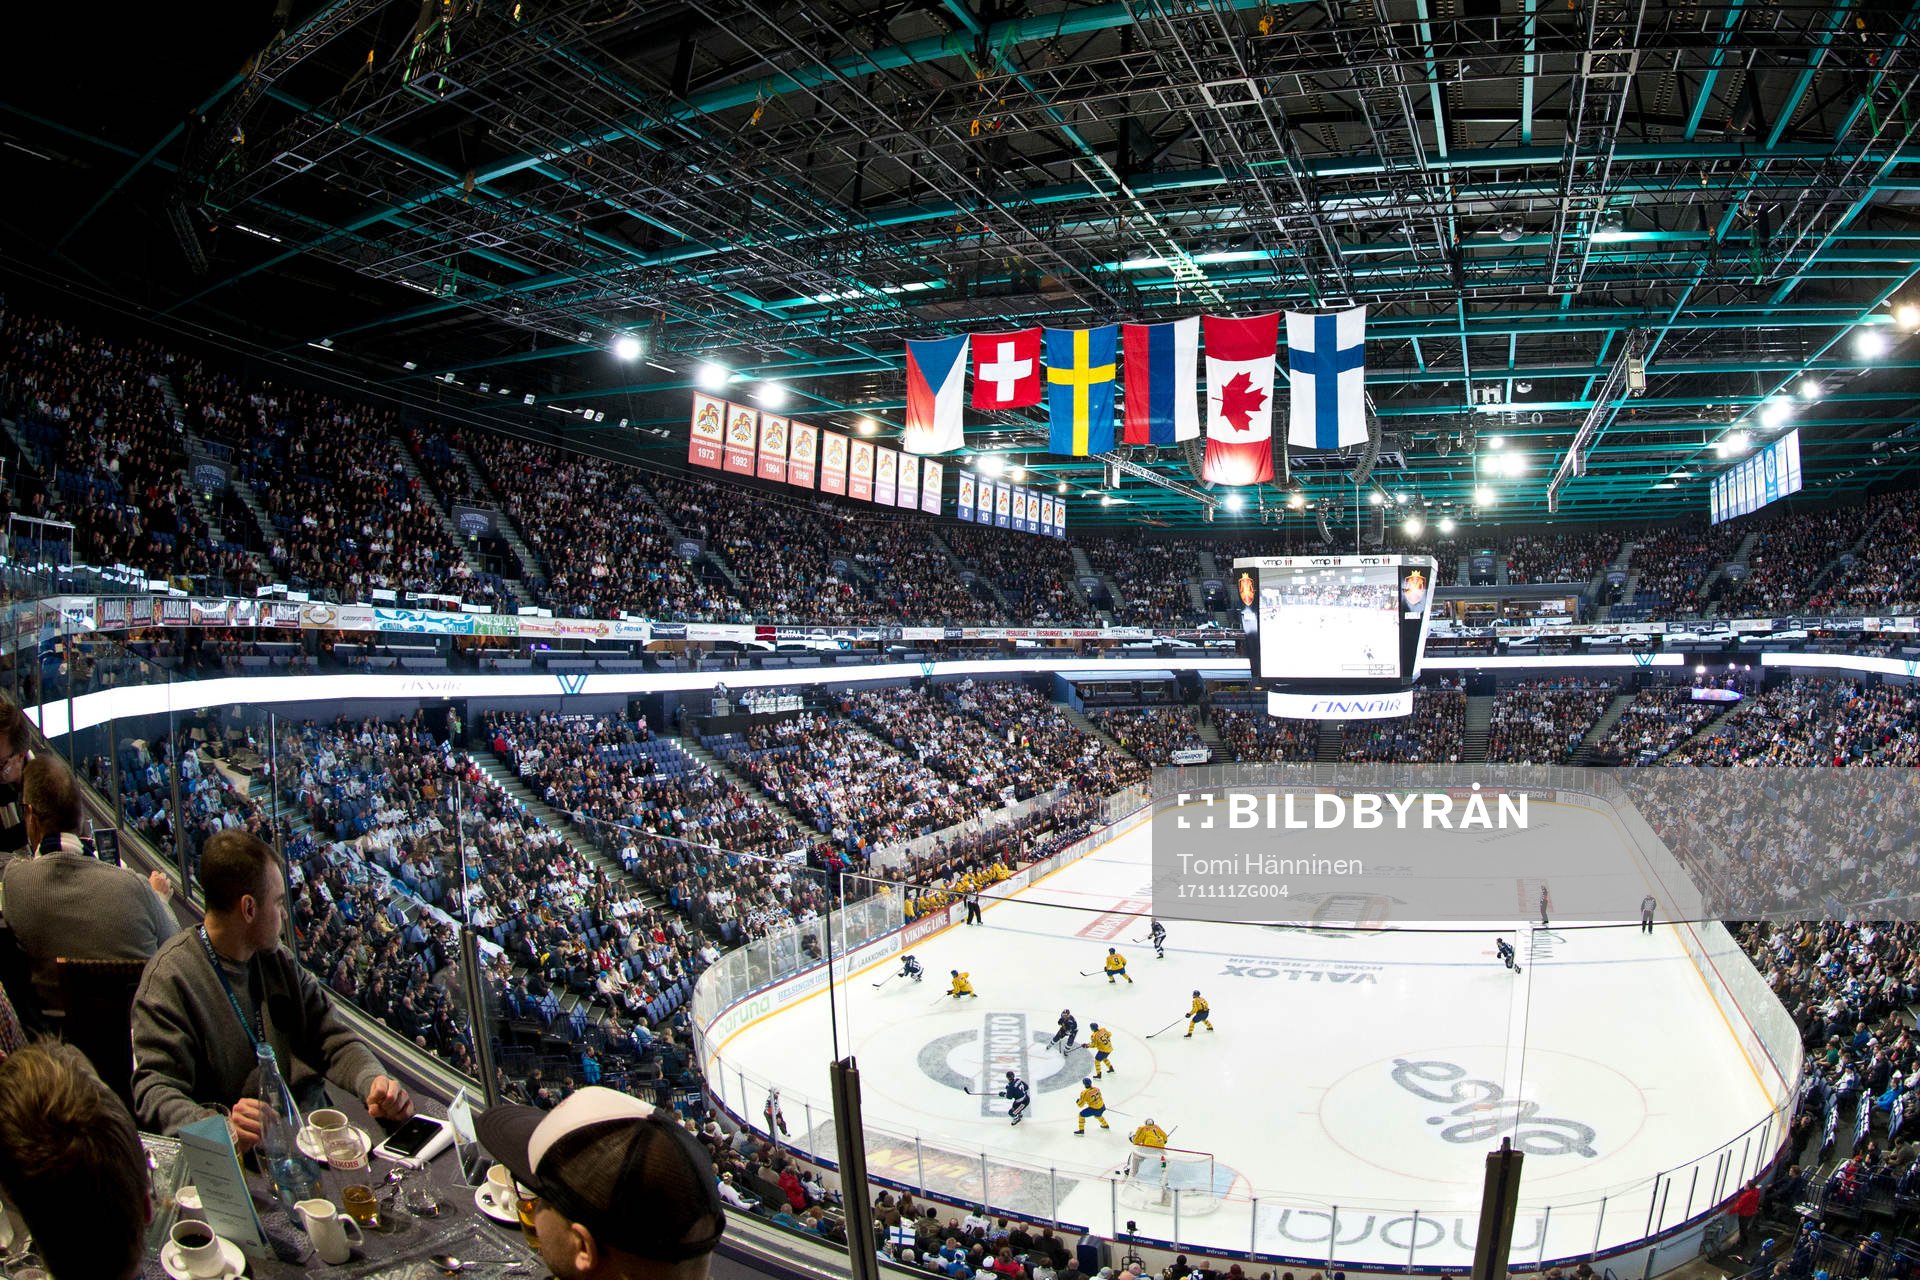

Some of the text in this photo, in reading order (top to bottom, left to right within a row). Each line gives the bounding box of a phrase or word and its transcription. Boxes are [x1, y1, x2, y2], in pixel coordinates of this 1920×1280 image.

[698, 447, 715, 460] 1973
[731, 455, 748, 467] 1992
[163, 601, 189, 618] KARJALA
[1311, 699, 1401, 713] FINNAIR
[904, 912, 949, 944] VIKING LINE
[857, 950, 890, 969] LAAKKONEN
[1217, 965, 1378, 985] VALLOX
[717, 994, 771, 1040] caruna
[1060, 1223, 1082, 1232] intrum
[1277, 1208, 1545, 1252] mora
[1206, 1248, 1229, 1256] intrum
[1285, 1257, 1308, 1265] intrum
[1362, 1263, 1385, 1271] intrum
